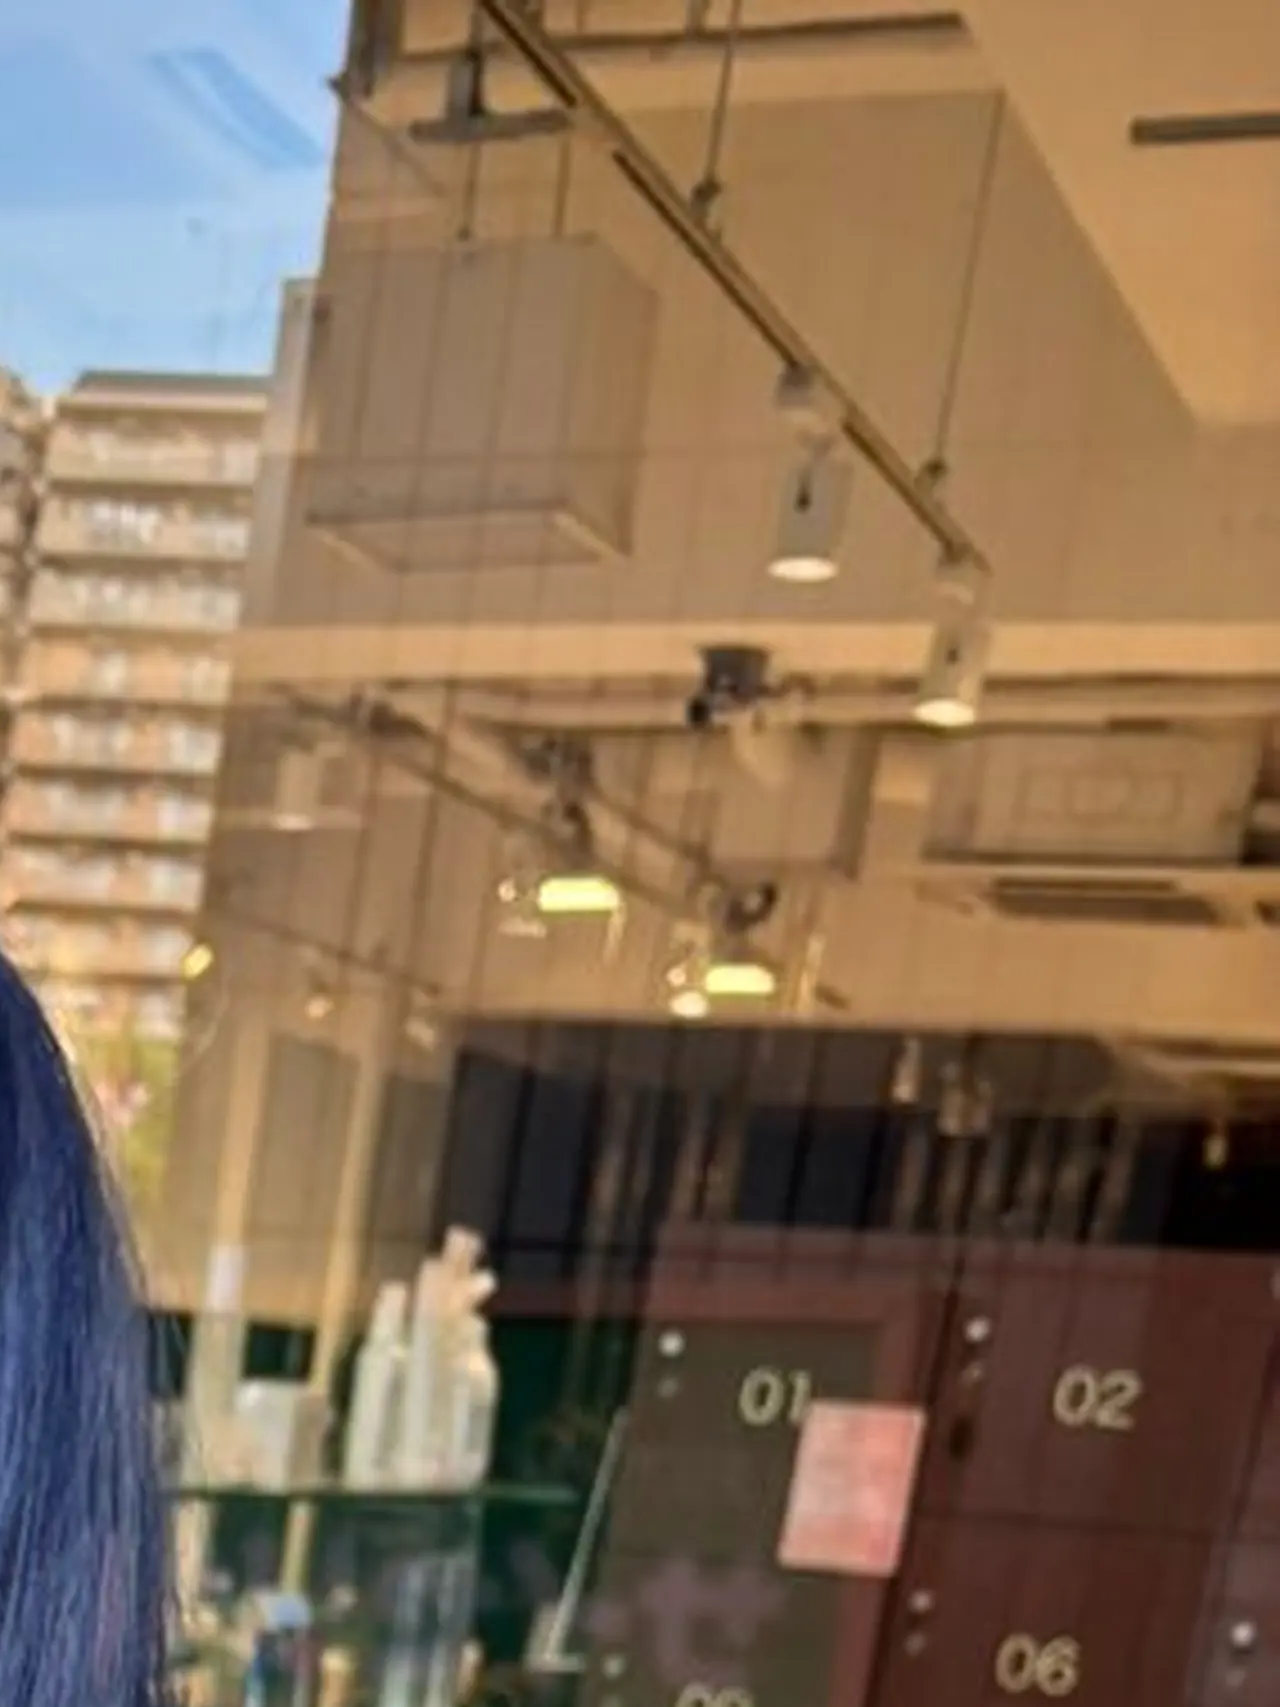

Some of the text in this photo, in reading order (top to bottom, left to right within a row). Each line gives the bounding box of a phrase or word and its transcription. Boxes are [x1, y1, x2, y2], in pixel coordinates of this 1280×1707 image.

[738, 1367, 814, 1426] 01
[1052, 1368, 1140, 1430] 02
[994, 1634, 1081, 1697] 06
